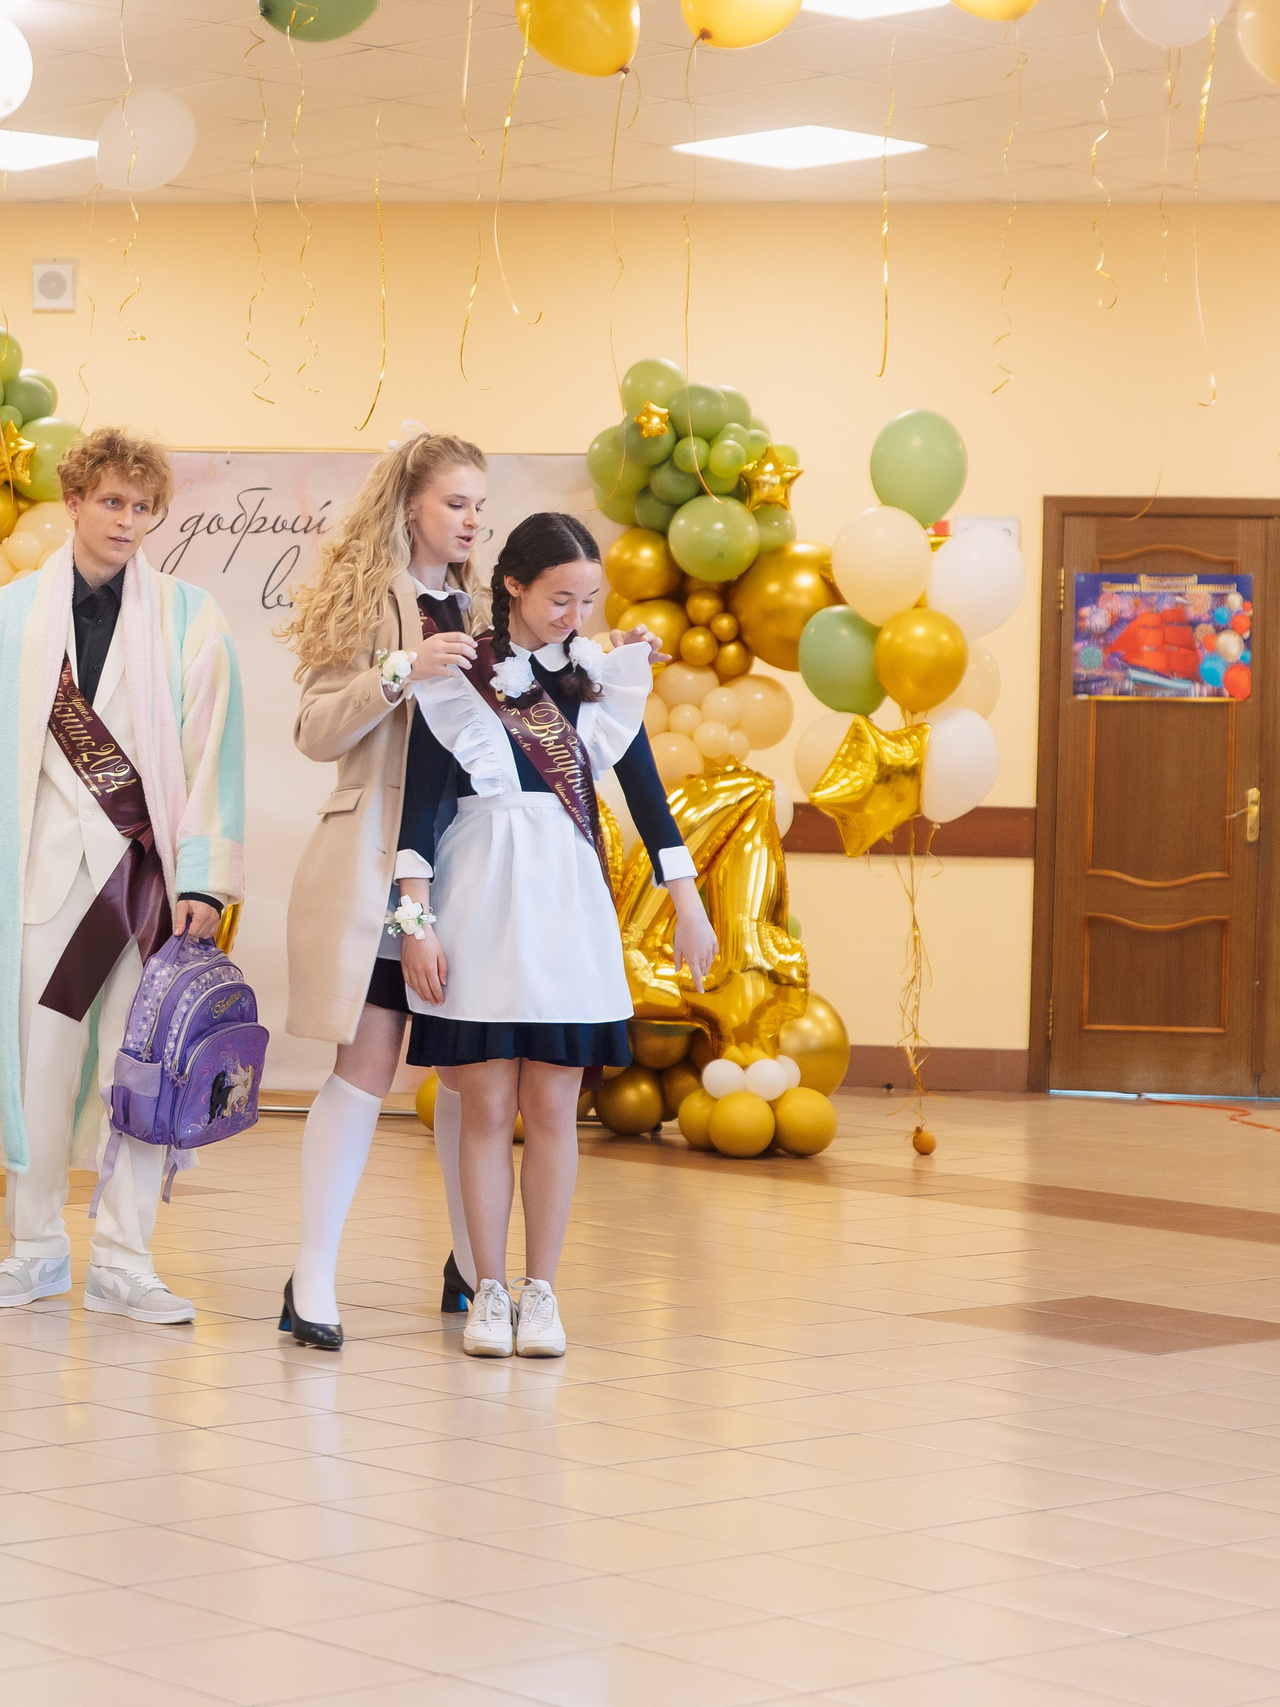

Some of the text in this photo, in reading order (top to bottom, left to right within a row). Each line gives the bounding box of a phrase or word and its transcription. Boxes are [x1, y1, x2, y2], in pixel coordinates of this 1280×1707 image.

[160, 487, 332, 575] добрый
[73, 756, 103, 797] Кронштадт
[80, 742, 137, 794] 2024
[522, 702, 597, 823] Выпускниц
[554, 781, 572, 805] Школа
